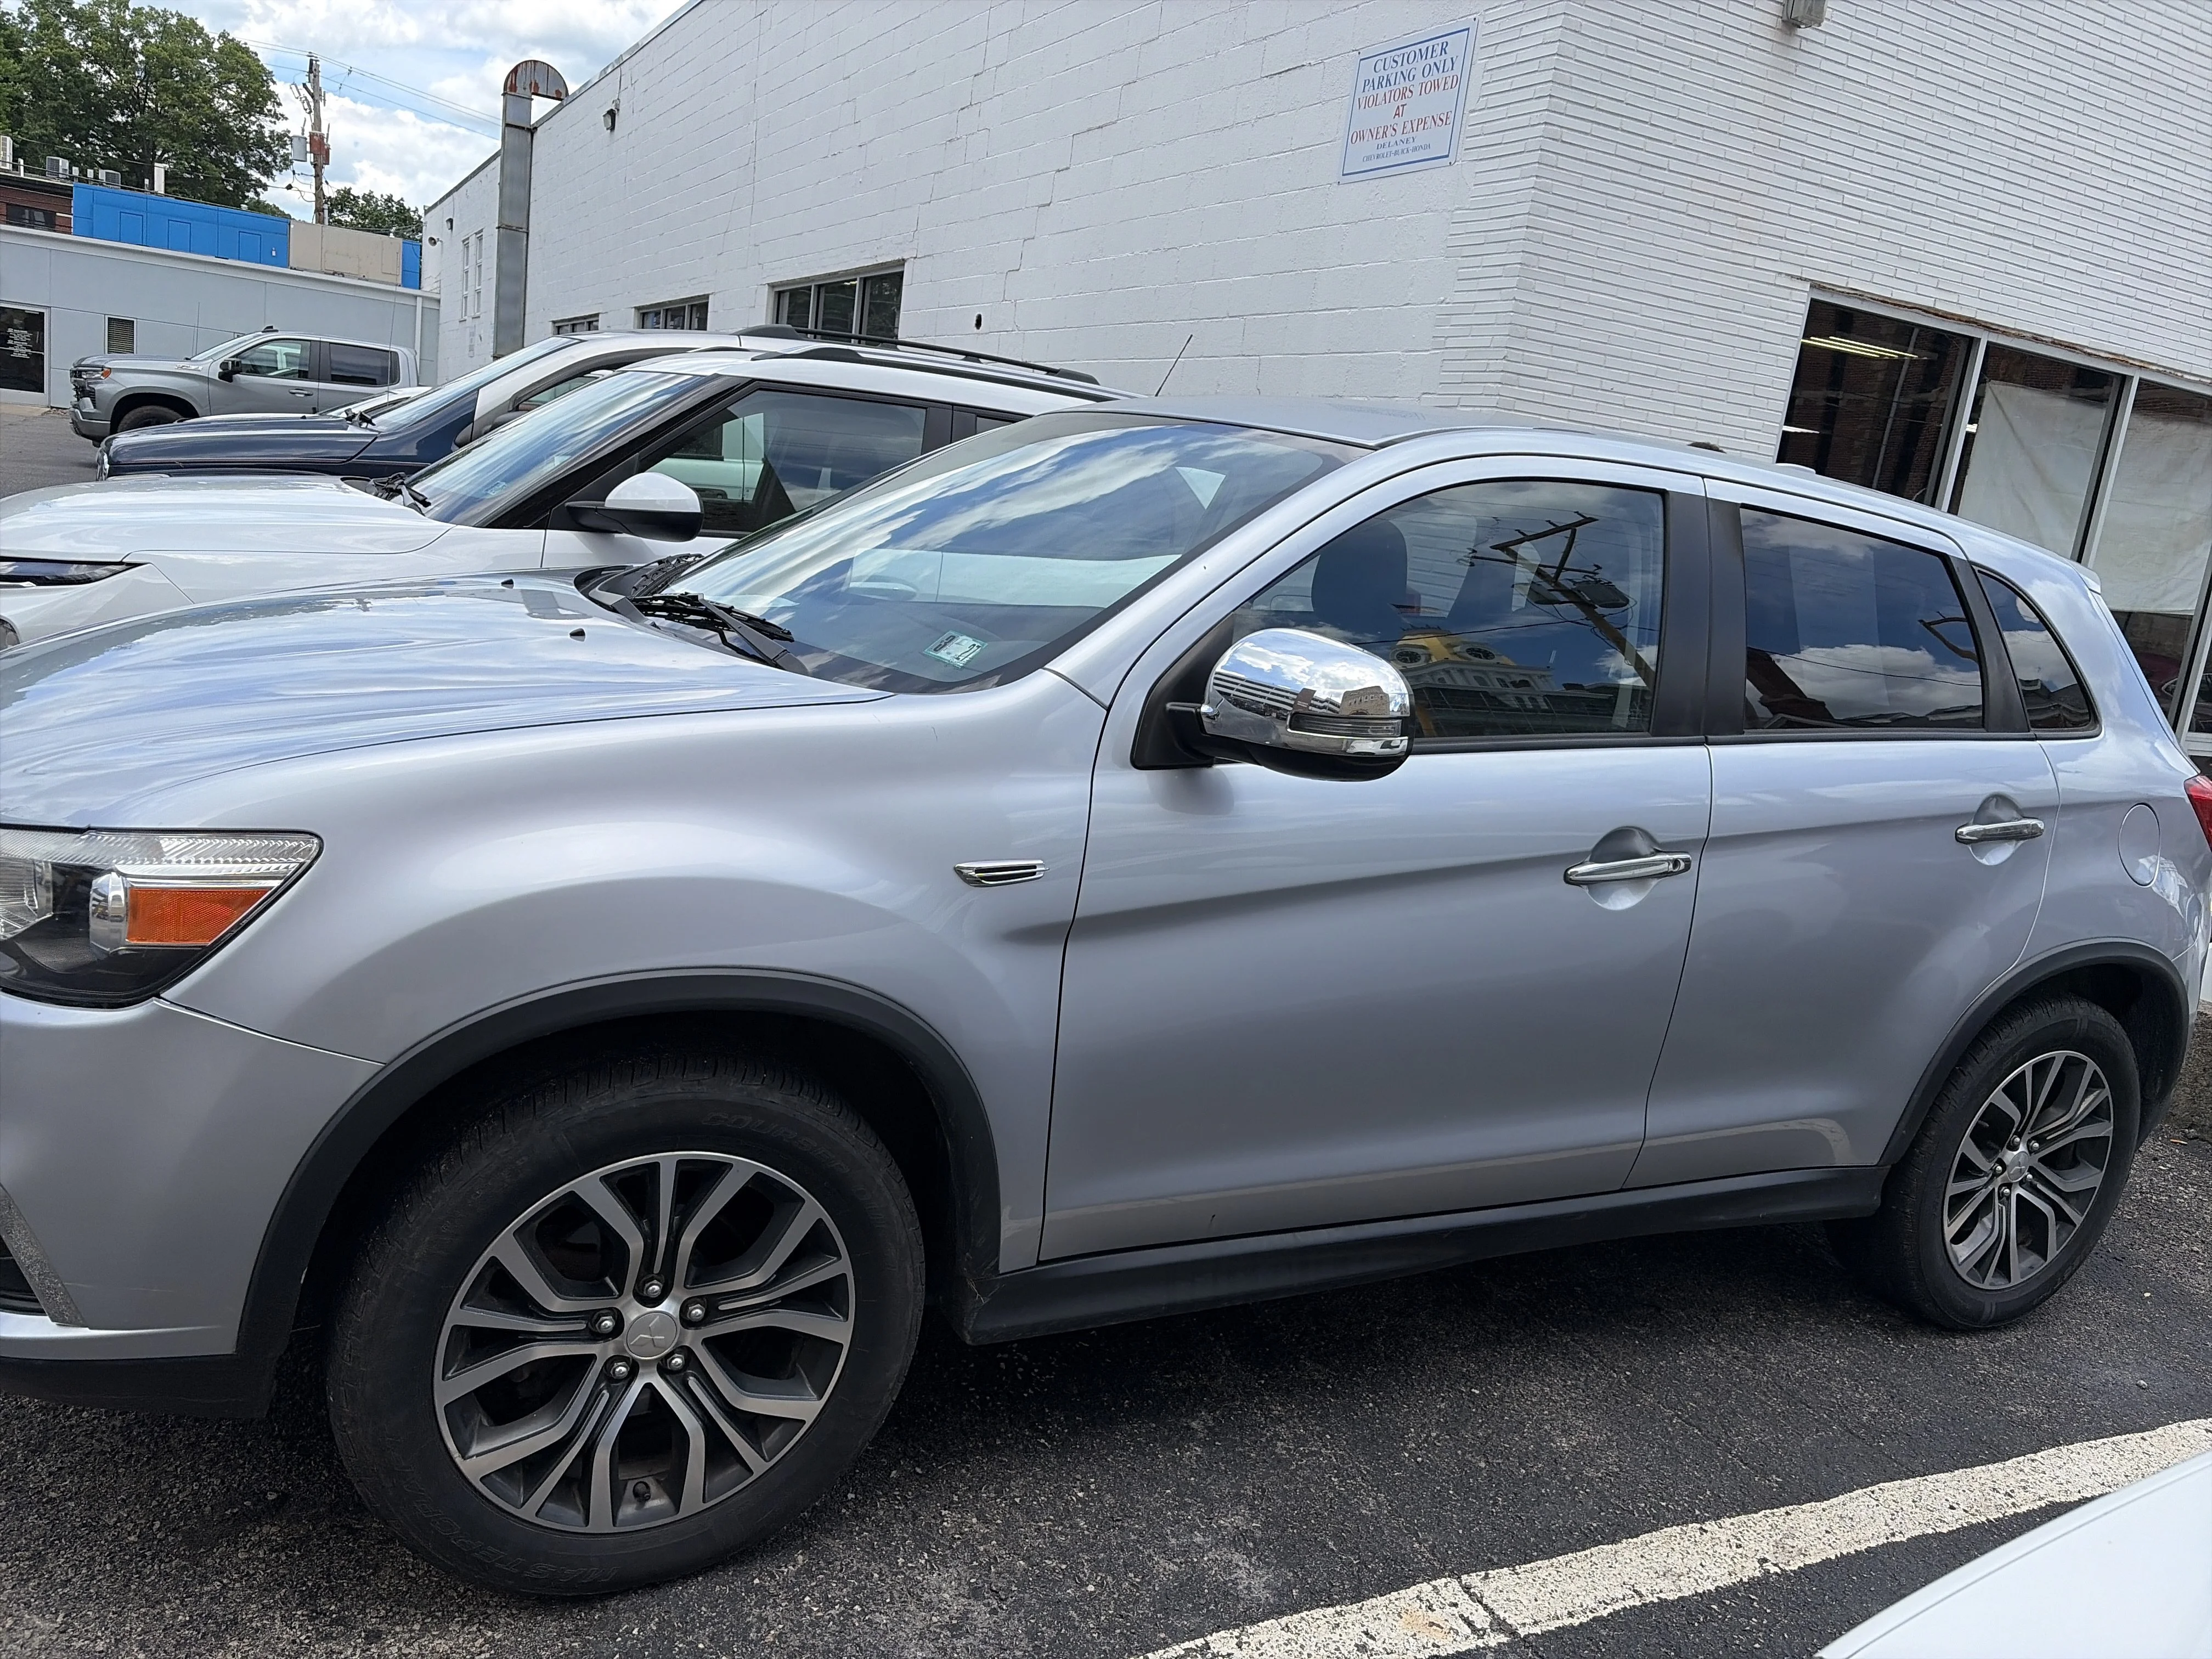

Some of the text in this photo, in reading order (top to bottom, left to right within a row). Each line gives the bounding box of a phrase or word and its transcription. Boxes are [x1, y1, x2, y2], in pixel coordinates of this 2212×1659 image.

[1374, 41, 1448, 72] CUSTOMER
[1362, 56, 1459, 93] PARKING ONLY
[1358, 75, 1458, 110] VIOLATORS TOWED
[1393, 104, 1407, 119] AT
[1351, 111, 1452, 144] OWNER'S EXPENSE
[1376, 137, 1417, 149] DELANEY
[955, 644, 981, 662] 27
